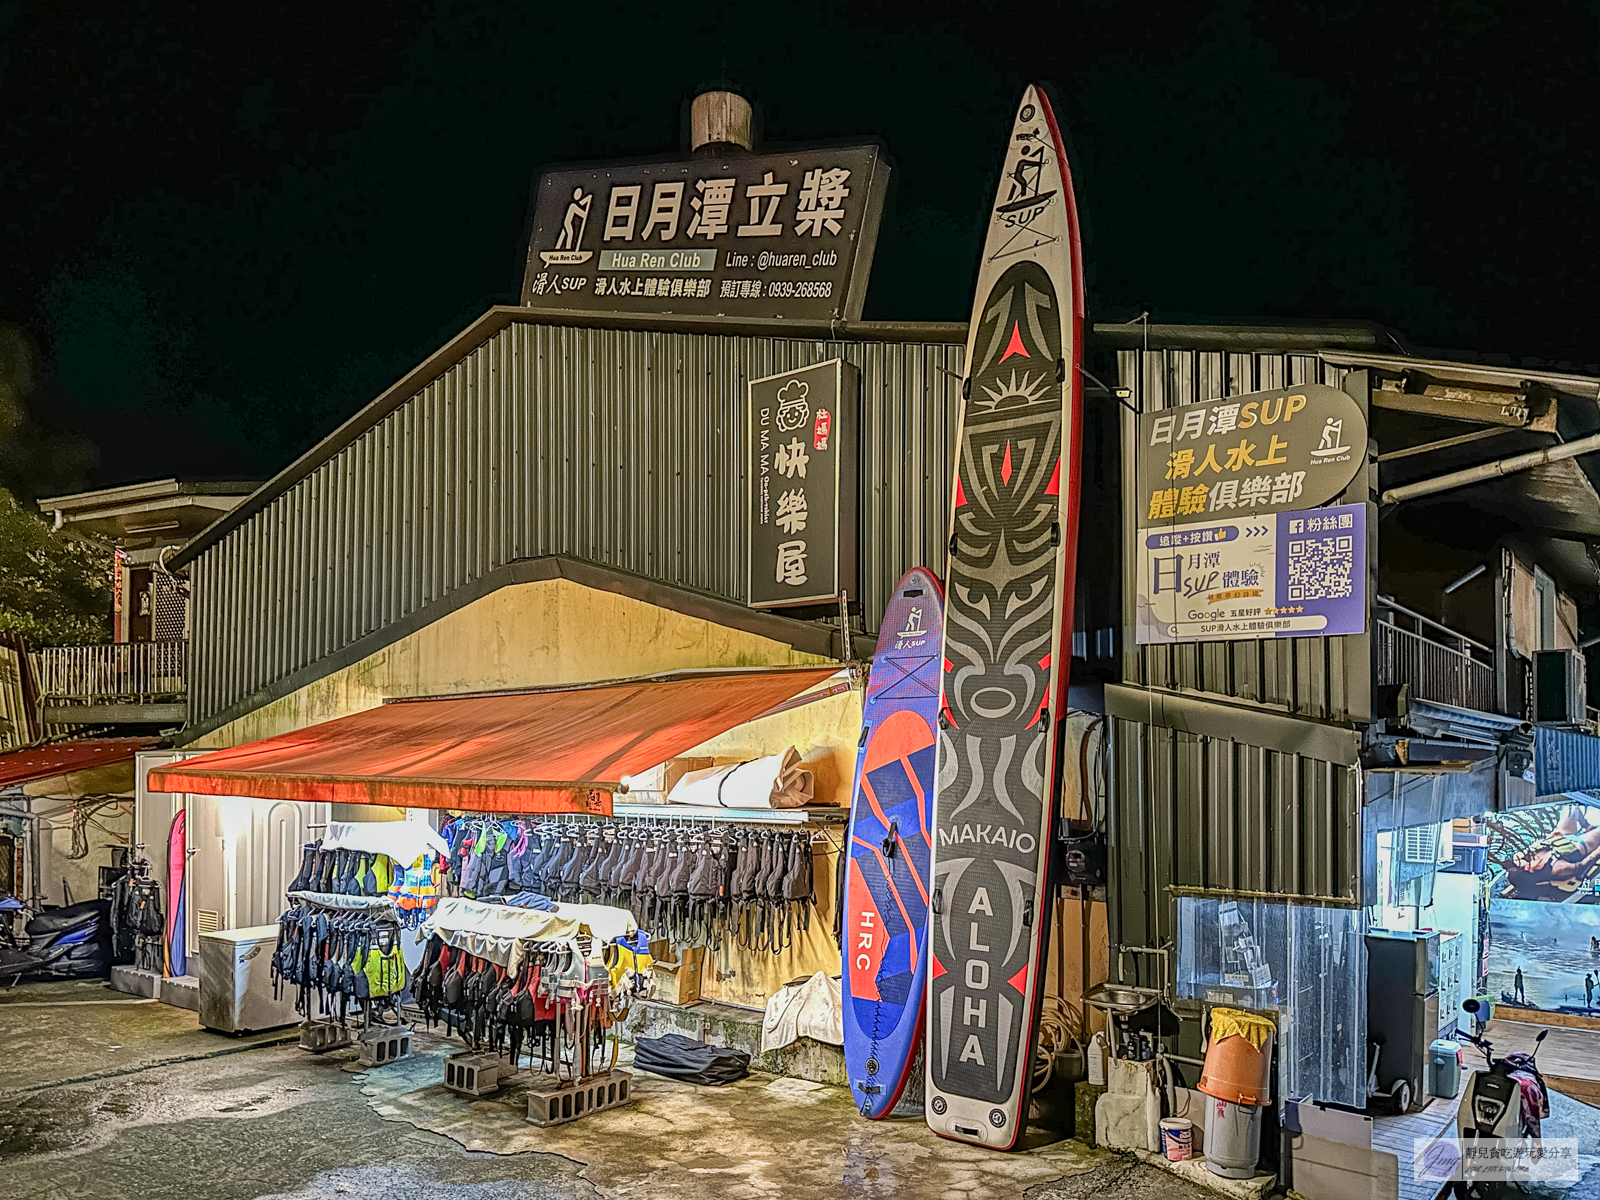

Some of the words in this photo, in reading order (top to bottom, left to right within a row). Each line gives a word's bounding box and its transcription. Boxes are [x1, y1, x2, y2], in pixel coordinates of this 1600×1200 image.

[603, 167, 851, 242] 日月潭立槳
[1005, 206, 1045, 229] SUP
[611, 252, 637, 268] Hua
[640, 252, 665, 268] Ren
[669, 252, 701, 268] Club
[725, 251, 748, 267] Line
[757, 250, 838, 271] @huaren_club
[594, 277, 712, 298] 滑人水上體驗俱樂部
[768, 281, 833, 298] 0939-268568
[760, 407, 770, 426] DU
[1149, 394, 1307, 447] 日月潭SUP
[760, 429, 770, 451] MA
[760, 453, 770, 476] MA
[1164, 434, 1288, 481] 滑人水上
[1148, 470, 1307, 520] 體驗俱樂部
[774, 436, 810, 586] 快樂屋
[1307, 513, 1353, 532] 粉絲團
[1159, 530, 1214, 547] 追蹤+按讚
[1183, 571, 1220, 598] SUP
[1222, 569, 1259, 588] 體驗
[1187, 608, 1225, 621] Google
[1230, 608, 1261, 618] 五星好評
[1201, 620, 1291, 633] SUP滑人水上體驗俱樂部
[938, 823, 1036, 854] MAKAIO
[856, 911, 876, 972] HRC
[958, 886, 995, 1067] ALOHA
